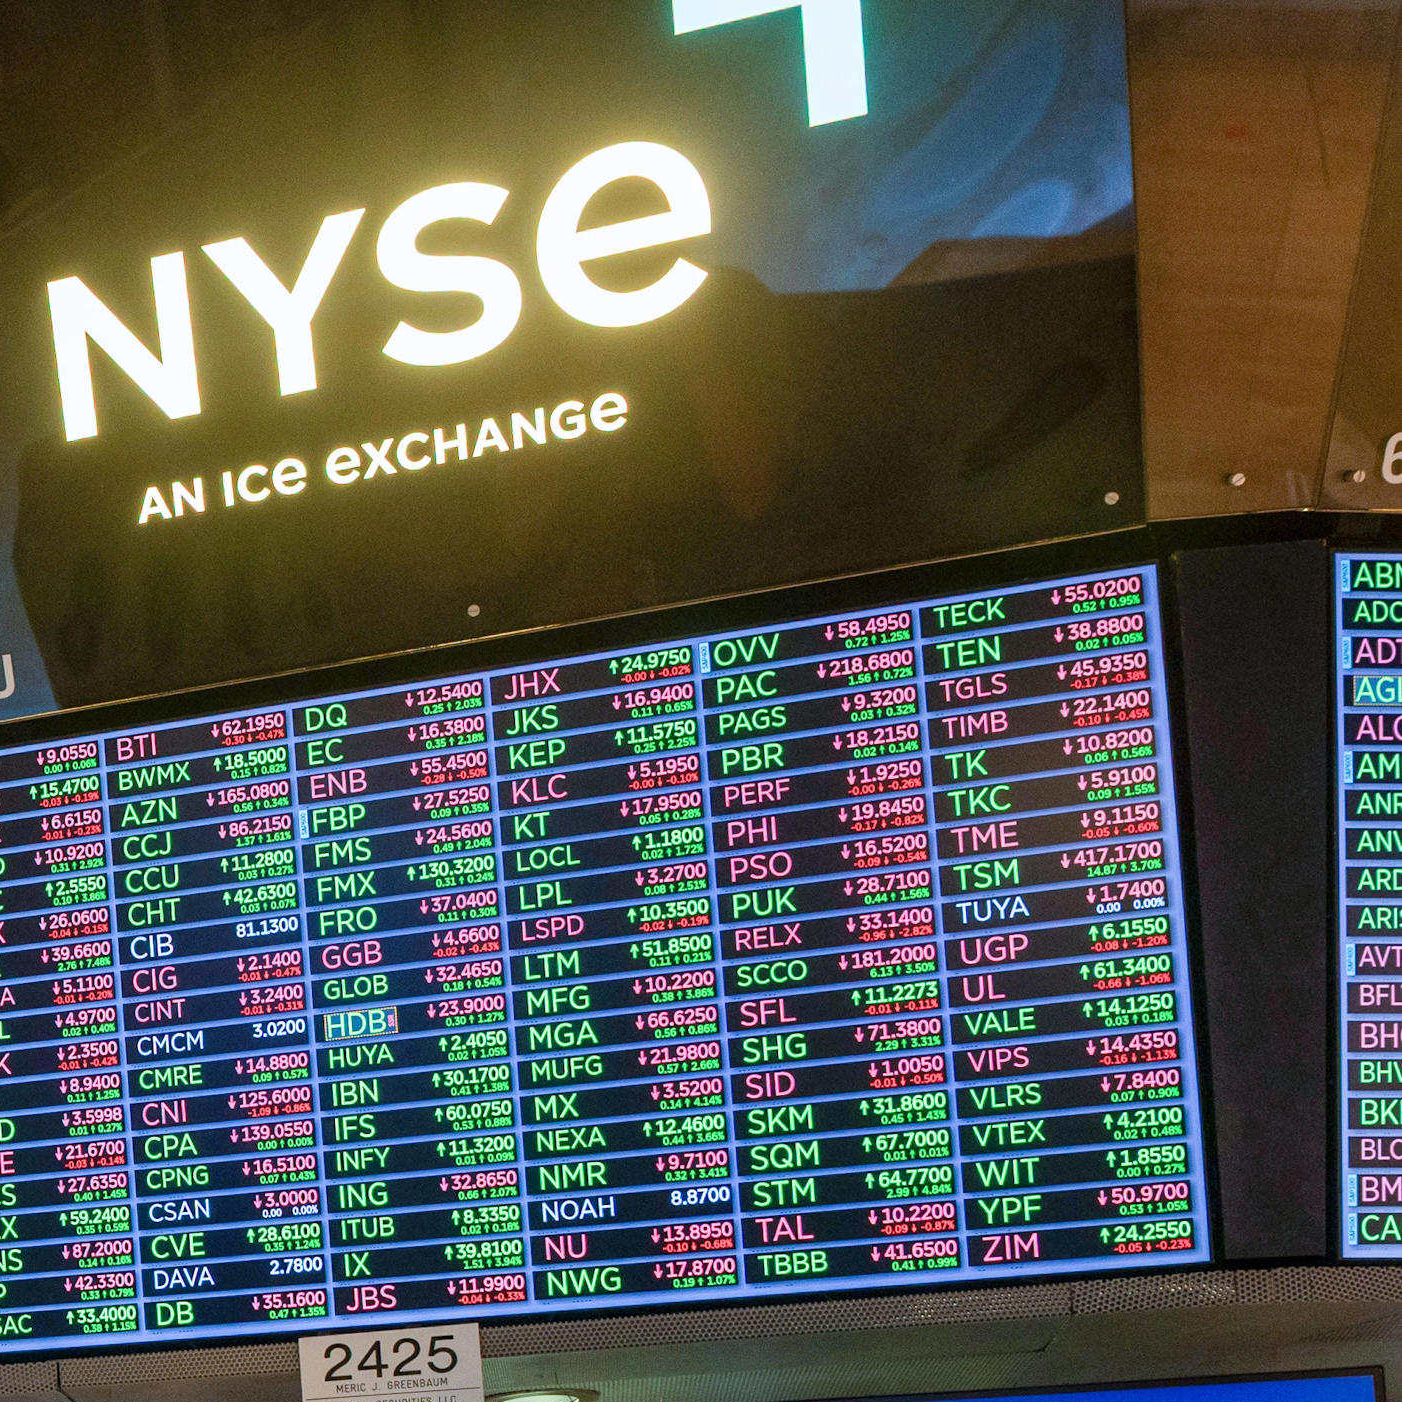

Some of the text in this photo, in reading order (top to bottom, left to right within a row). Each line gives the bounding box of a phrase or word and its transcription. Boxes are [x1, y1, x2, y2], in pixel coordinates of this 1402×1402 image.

[139, 477, 206, 525] AN
[933, 577, 1140, 628] TECK 55.0200
[714, 613, 910, 666] OVV 58.4950
[305, 681, 482, 731] DQ 12.5400
[47, 743, 97, 765] 9.0550
[119, 747, 286, 790] BWMX 18.5000
[542, 1186, 730, 1222] NOAH 8.8700
[982, 1219, 1191, 1262] ZIM 24.2550
[324, 1335, 458, 1381] 2425
[336, 1383, 366, 1393] MERIC
[388, 1377, 448, 1389] GREENBAUM
